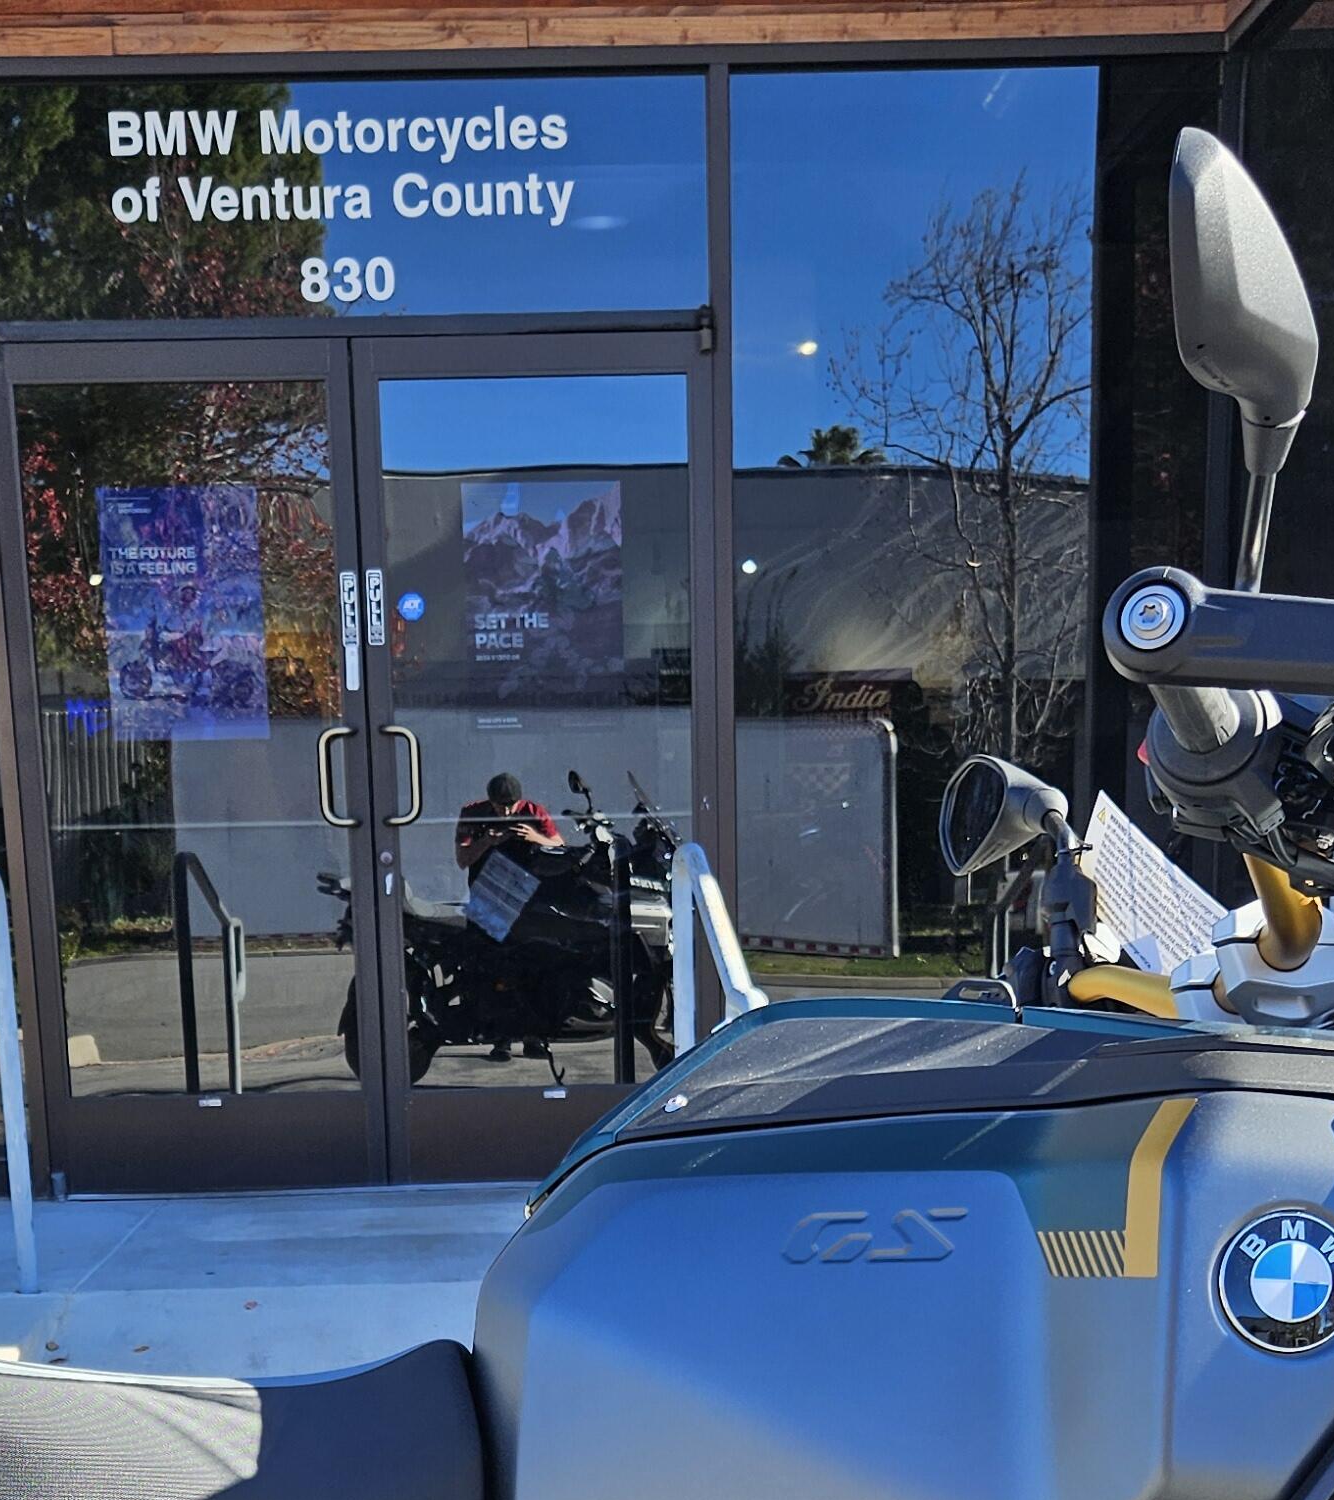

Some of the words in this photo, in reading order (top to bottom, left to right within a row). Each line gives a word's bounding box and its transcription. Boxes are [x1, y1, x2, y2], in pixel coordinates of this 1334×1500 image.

[107, 109, 237, 157] BMW
[260, 105, 569, 164] Motorcycles
[111, 176, 161, 223] of
[177, 174, 372, 221] Ventura
[392, 172, 575, 226] County
[300, 256, 395, 302] 830
[109, 547, 138, 560] THE
[140, 546, 196, 560] FUTURE
[110, 562, 124, 576] IS
[125, 562, 137, 575] A
[138, 562, 198, 576] FEELING
[342, 579, 355, 628] PULL
[369, 577, 381, 627] PULL
[474, 612, 509, 630] SET
[513, 612, 549, 629] THE
[475, 632, 525, 649] PACE
[782, 1206, 969, 1264] GS
